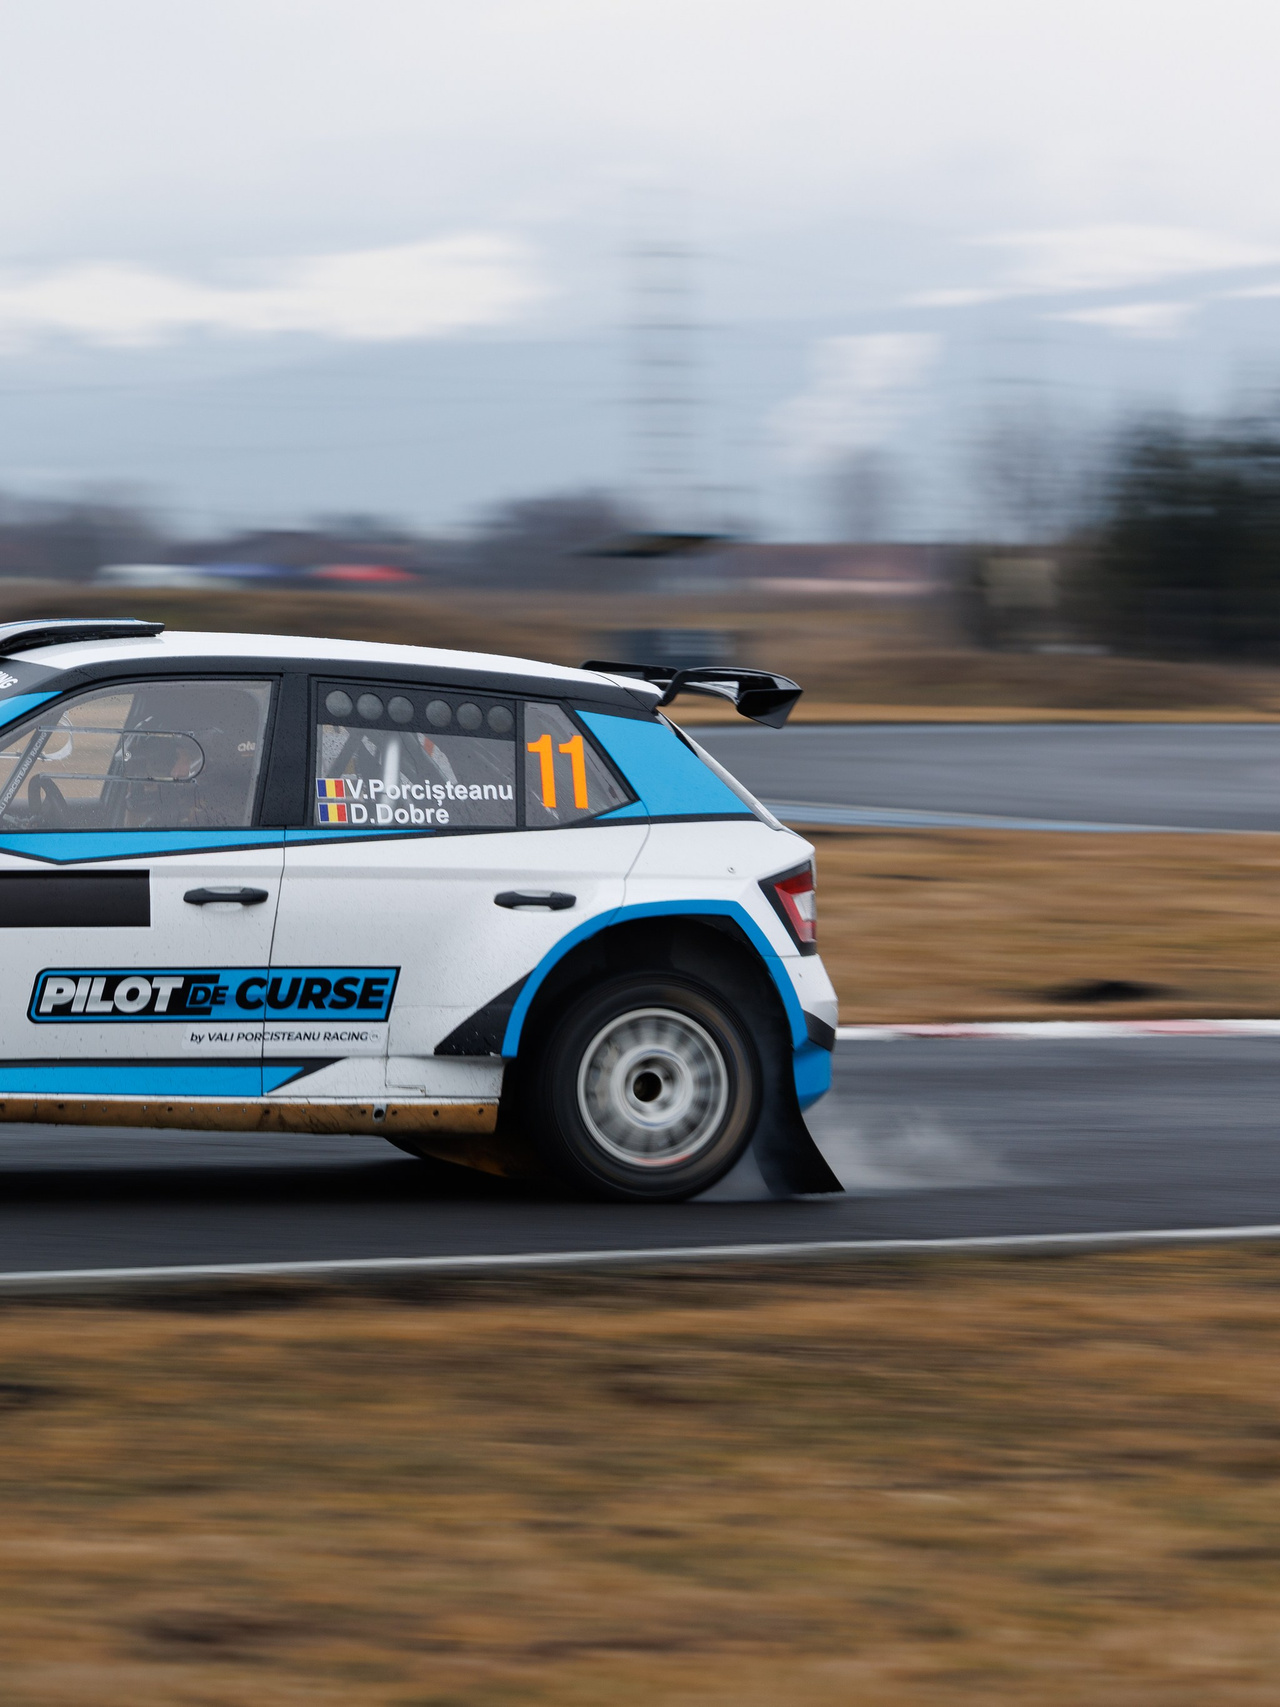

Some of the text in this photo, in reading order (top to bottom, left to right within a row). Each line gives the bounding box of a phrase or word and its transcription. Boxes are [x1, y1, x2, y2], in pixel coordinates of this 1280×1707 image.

[5, 754, 33, 804] PORCISTEANU
[31, 731, 47, 757] RACING
[526, 734, 588, 809] 11
[350, 803, 450, 824] D.Dobre
[39, 976, 390, 1013] PILOT DE CURSE
[190, 1032, 204, 1043] by
[208, 1032, 234, 1042] VALI
[236, 1031, 320, 1042] PORCISTEANU
[323, 1031, 368, 1041] RACING
